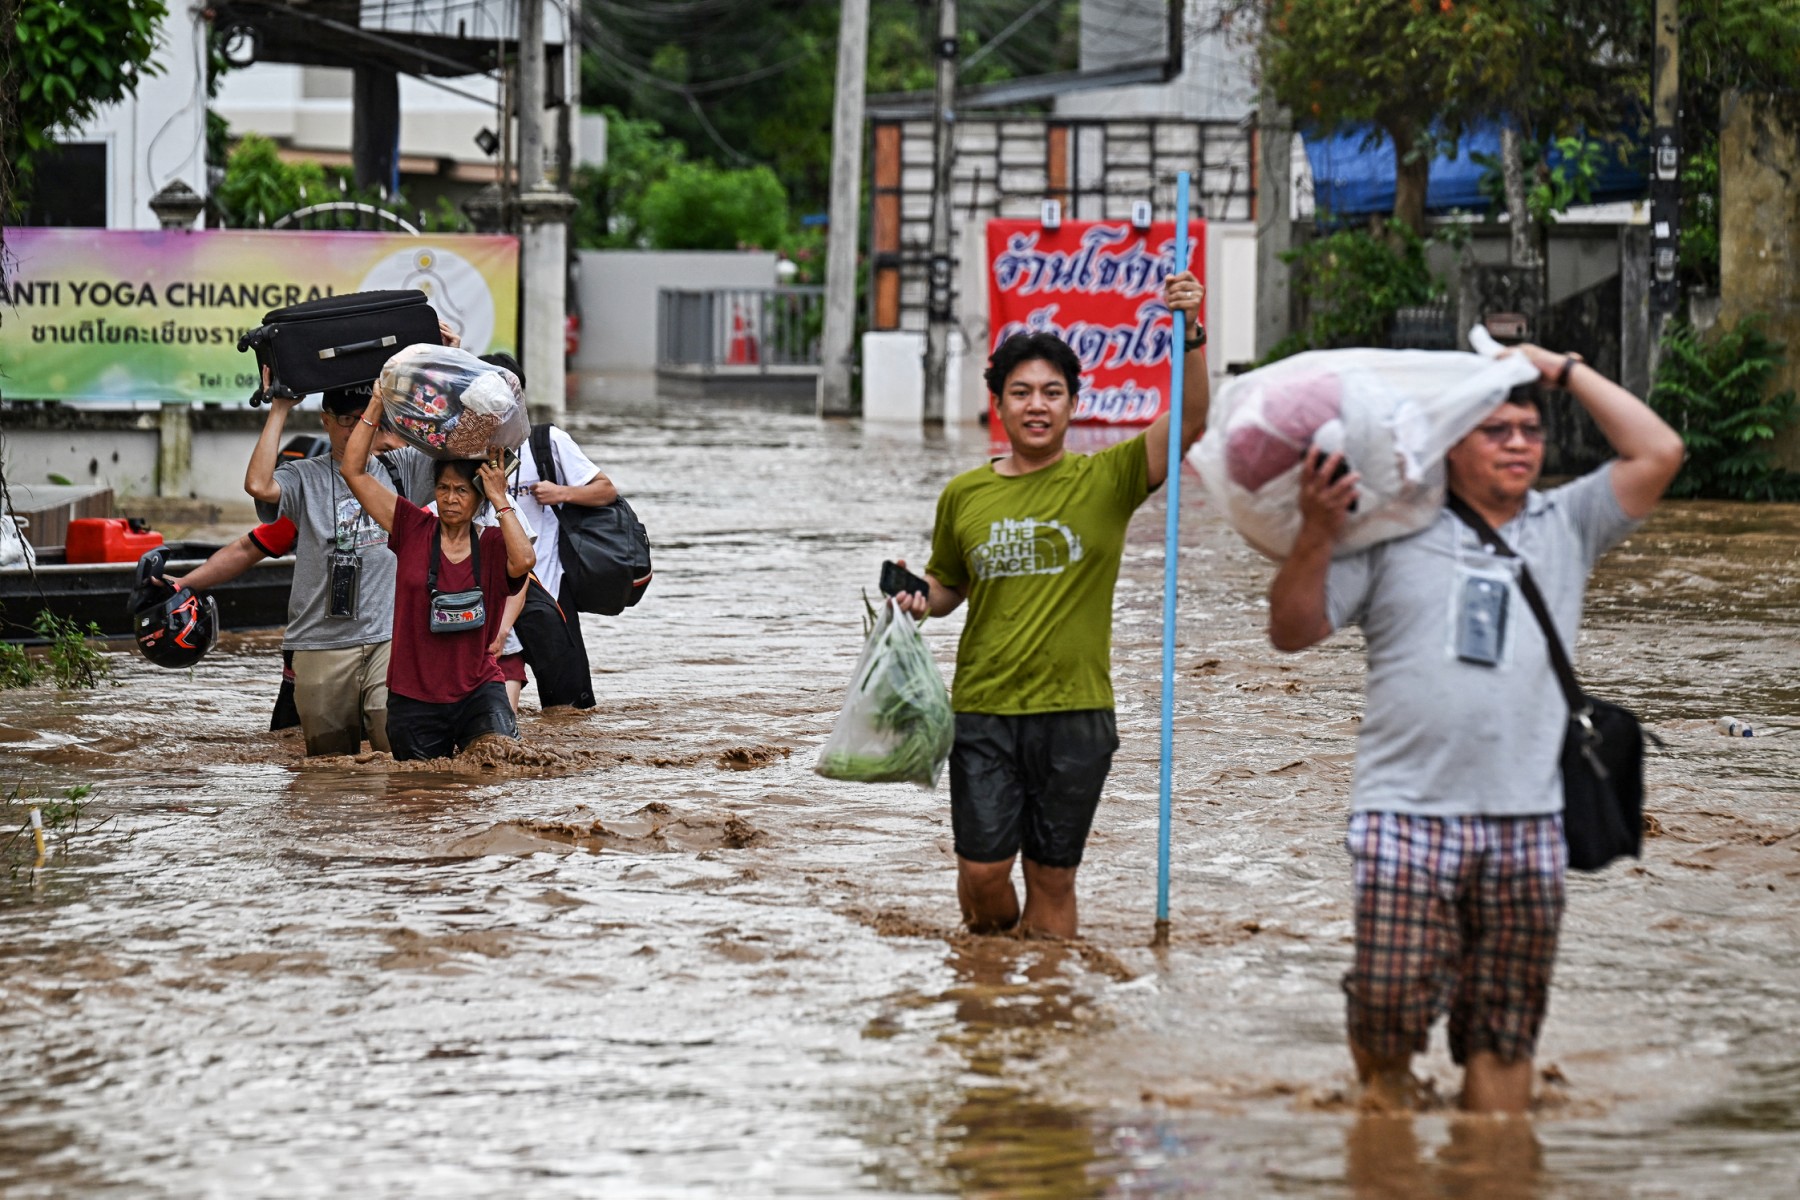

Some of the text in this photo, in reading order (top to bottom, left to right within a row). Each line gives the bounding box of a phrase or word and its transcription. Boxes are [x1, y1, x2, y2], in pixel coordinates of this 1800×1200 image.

[68, 281, 158, 306] YOGA
[992, 527, 1034, 542] THE
[983, 557, 1033, 577] FACE
